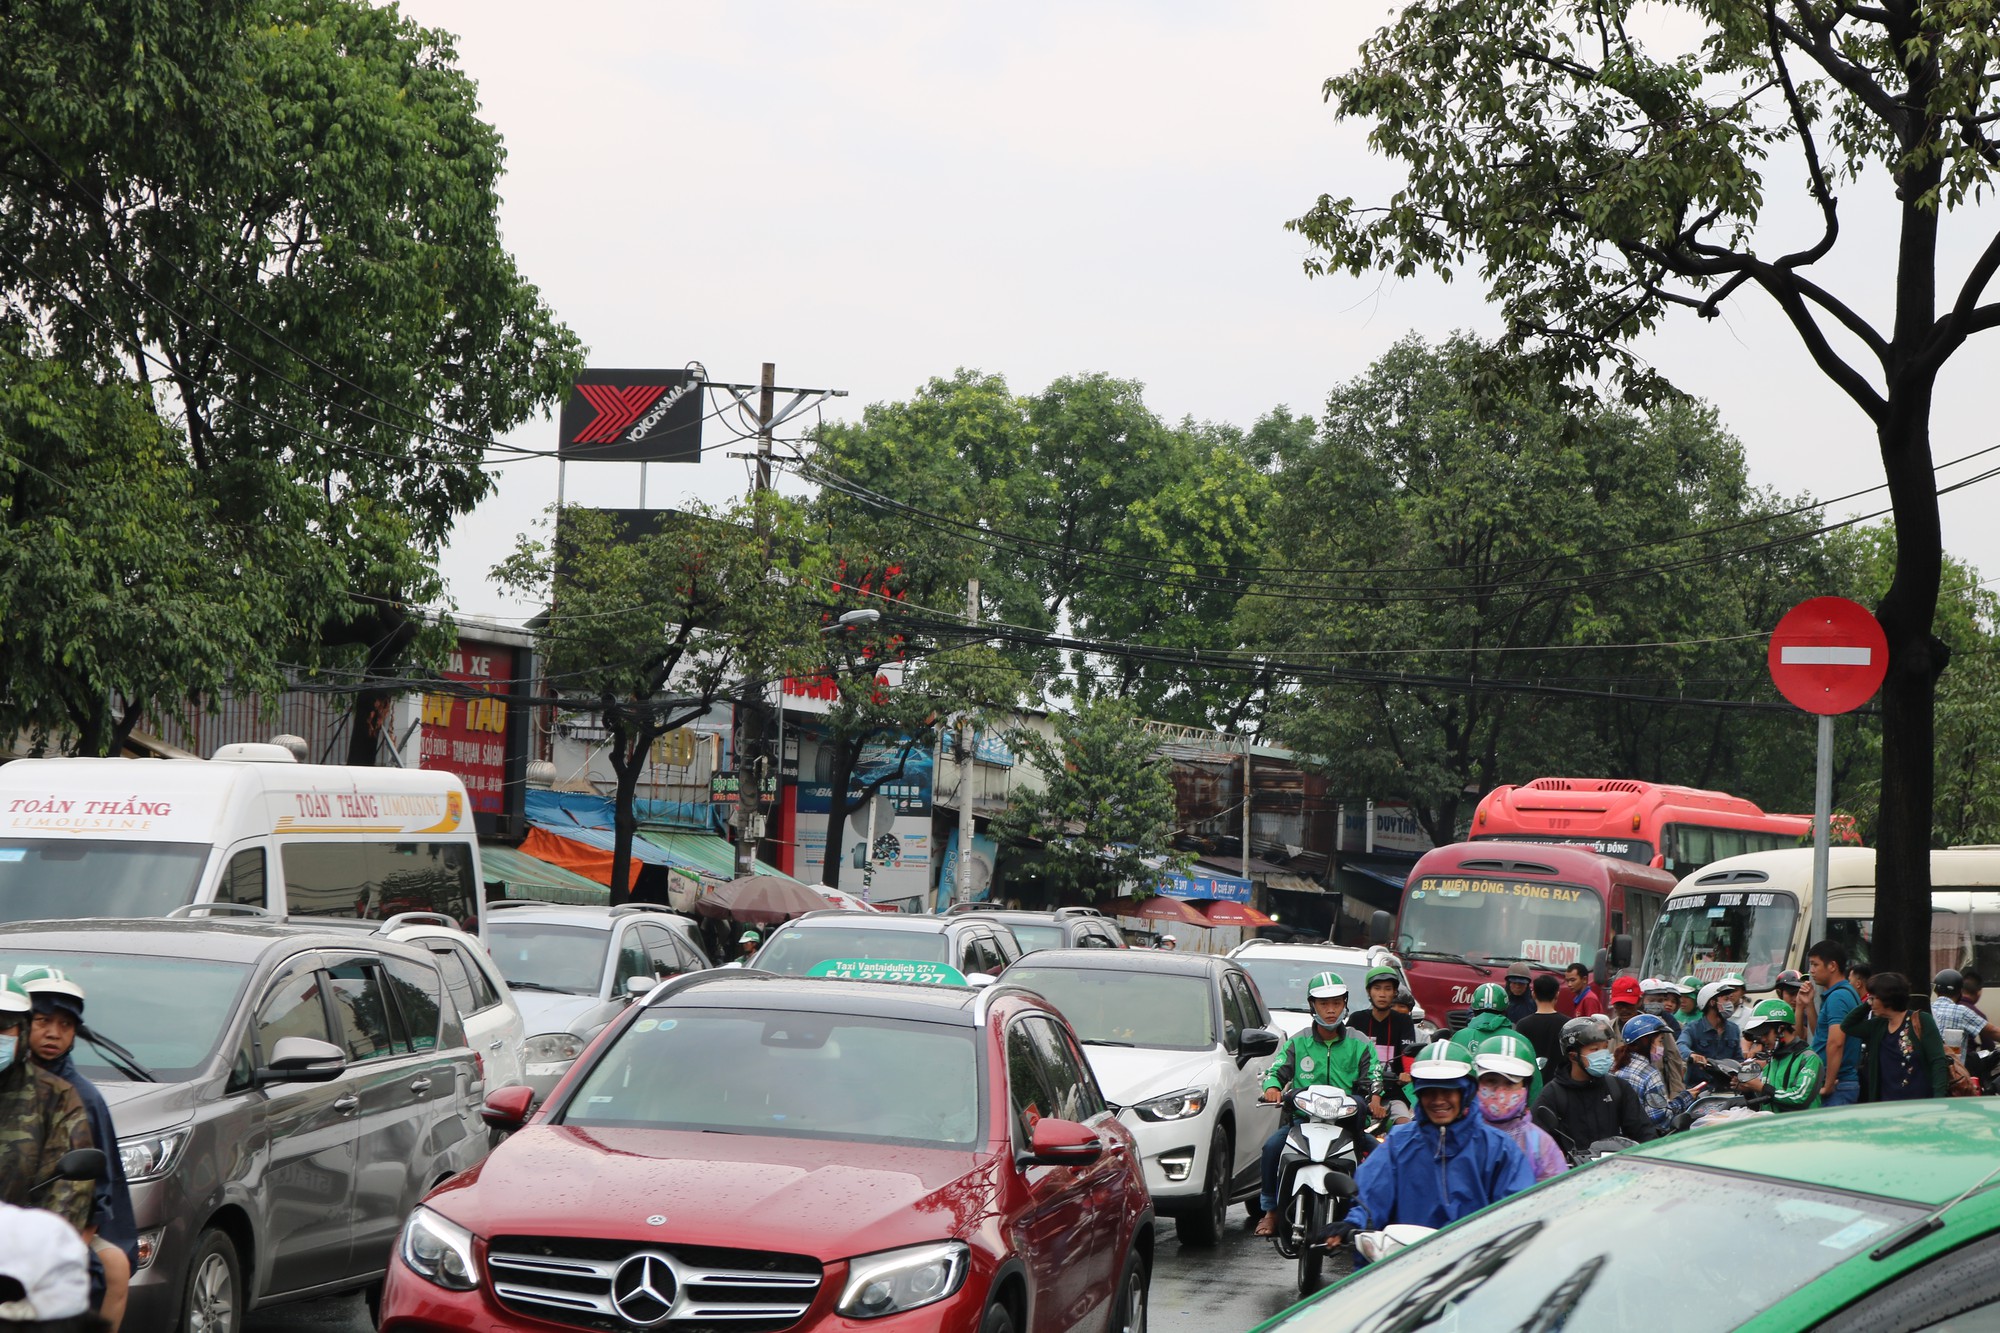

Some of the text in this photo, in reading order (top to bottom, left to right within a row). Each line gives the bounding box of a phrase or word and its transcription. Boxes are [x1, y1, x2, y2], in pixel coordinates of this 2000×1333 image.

[470, 655, 491, 676] XE
[381, 795, 440, 816] LIMOUSINE
[12, 817, 152, 829] LIMOUSINE
[1548, 818, 1571, 829] VIP
[1513, 883, 1550, 899] SÔNG
[1552, 888, 1581, 902] RAY
[1526, 941, 1575, 965] SÀI GÒN
[835, 961, 937, 973] Taxi Vantaidulich 27-7
[1769, 1009, 1788, 1017] Grab
[1299, 1071, 1315, 1080] Grab
